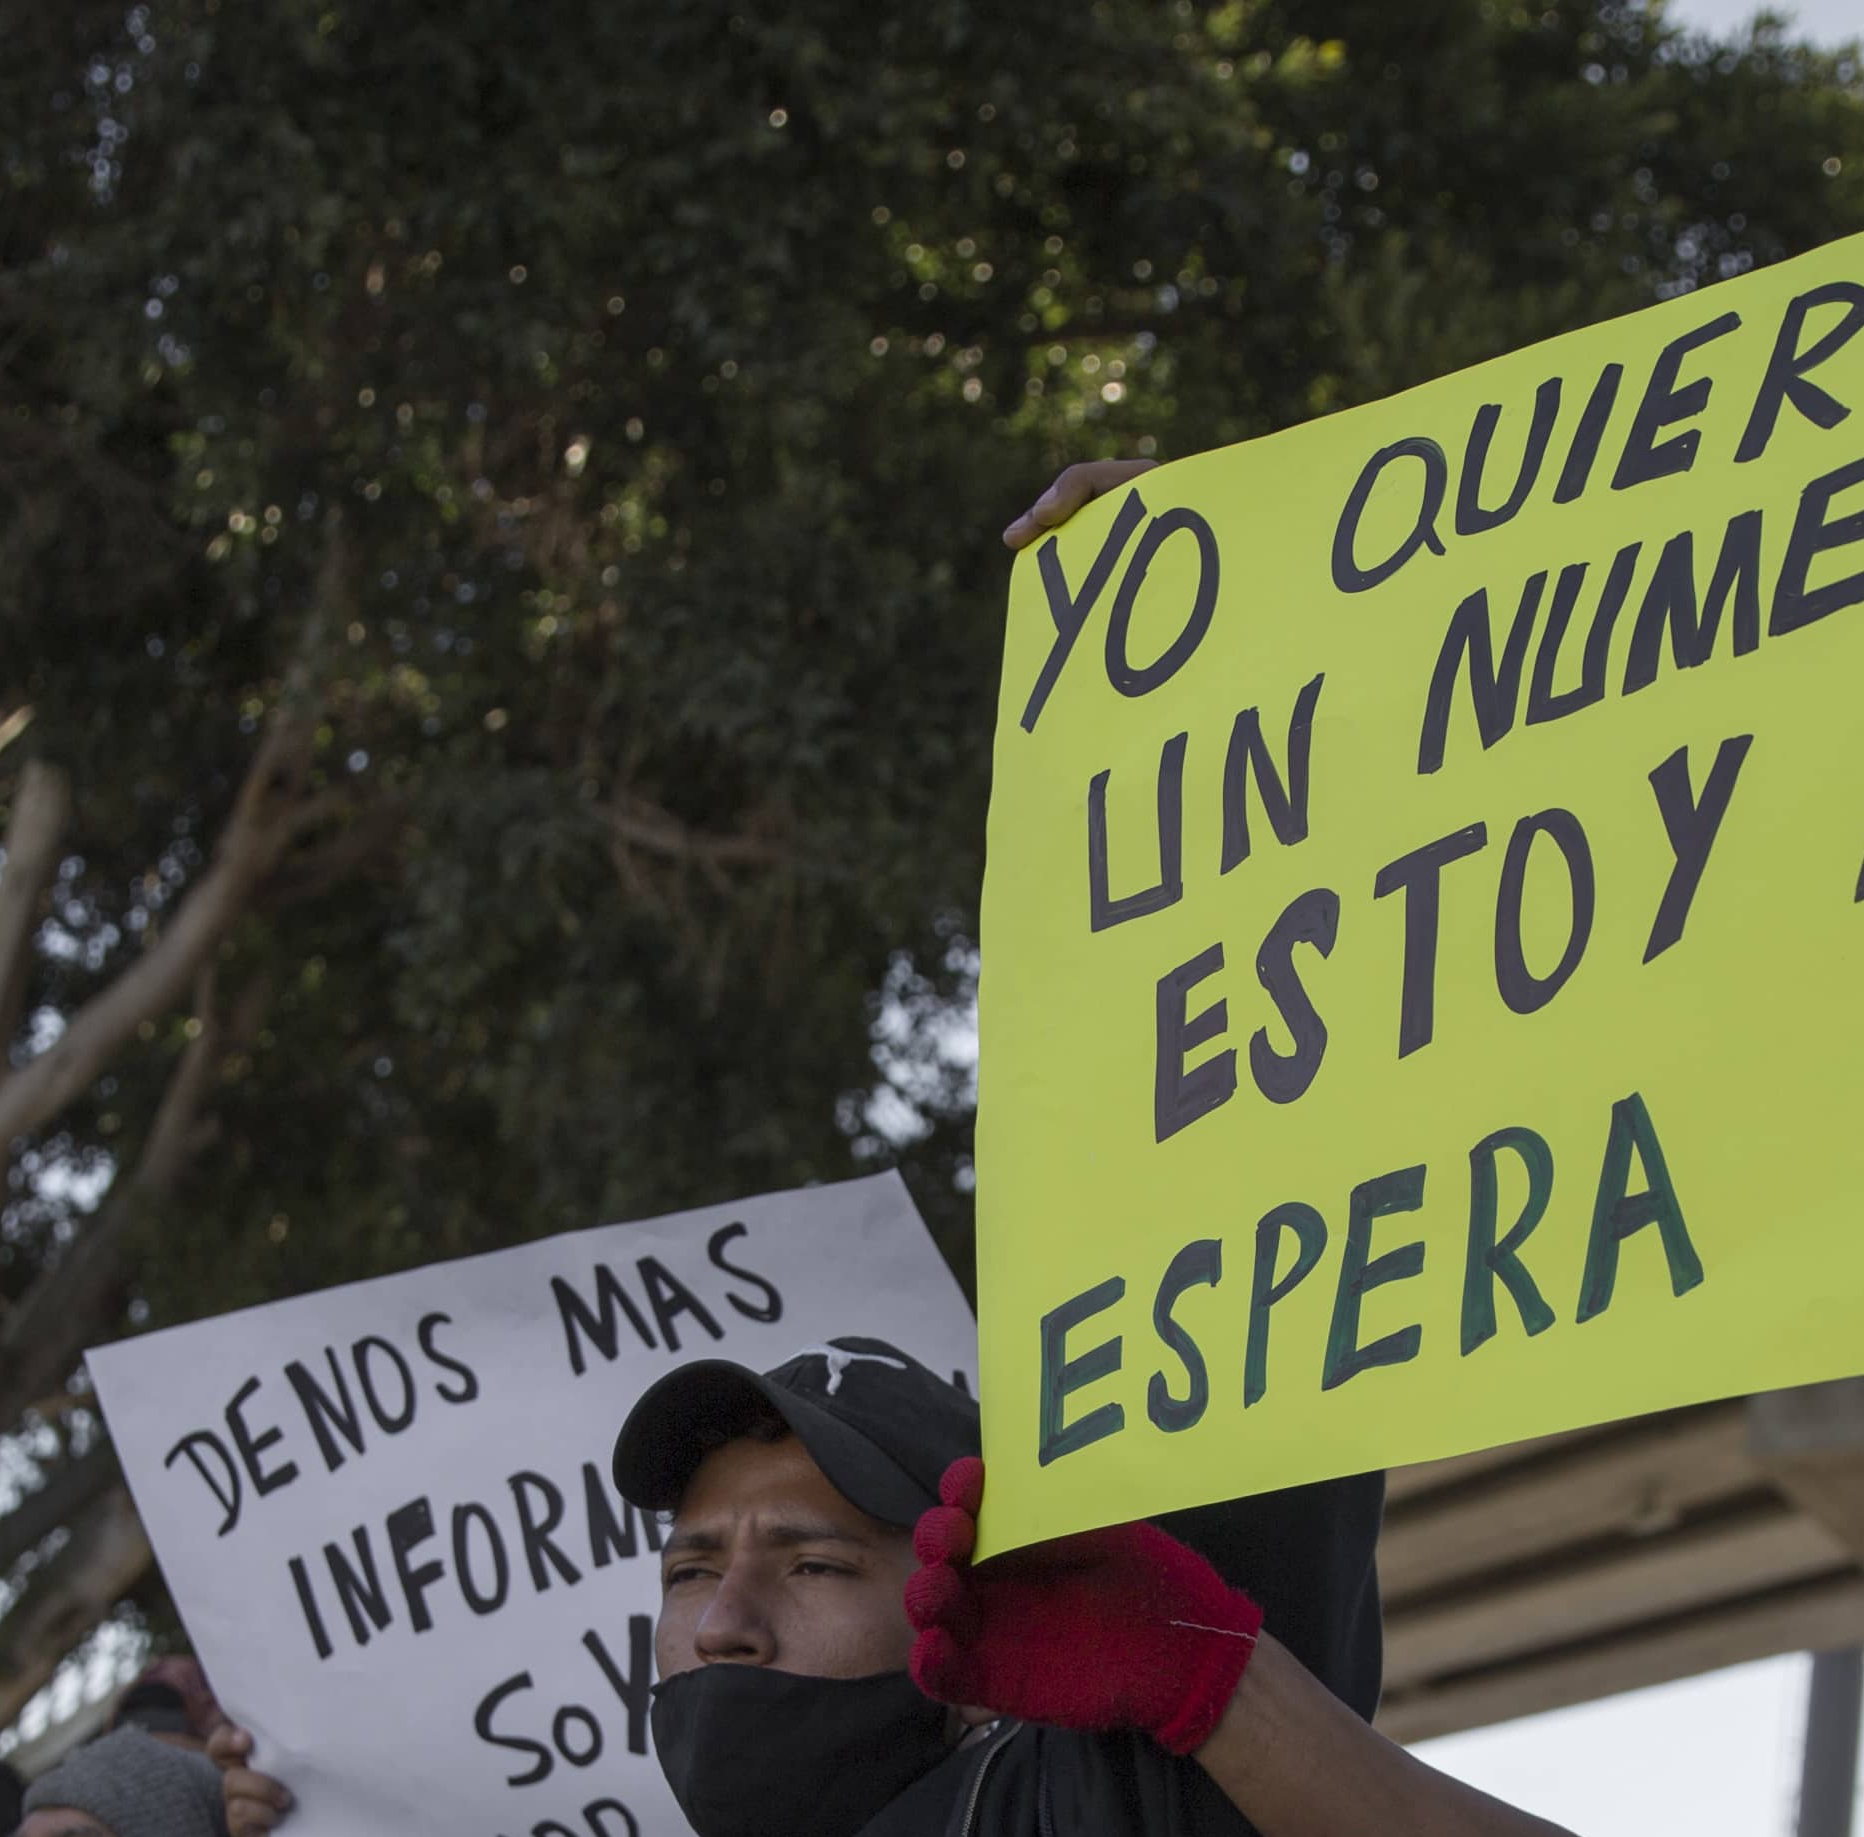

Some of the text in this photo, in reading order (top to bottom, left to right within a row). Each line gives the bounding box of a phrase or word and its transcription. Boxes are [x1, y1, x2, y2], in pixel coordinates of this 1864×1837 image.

[1020, 488, 1220, 734] YO
[1088, 672, 1325, 933] UN
[1155, 733, 1754, 1144] ESTOY
[164, 1221, 783, 1537] DENOS MAS
[1038, 1092, 1704, 1467] ESPERA
[289, 1462, 662, 1660] INFORM
